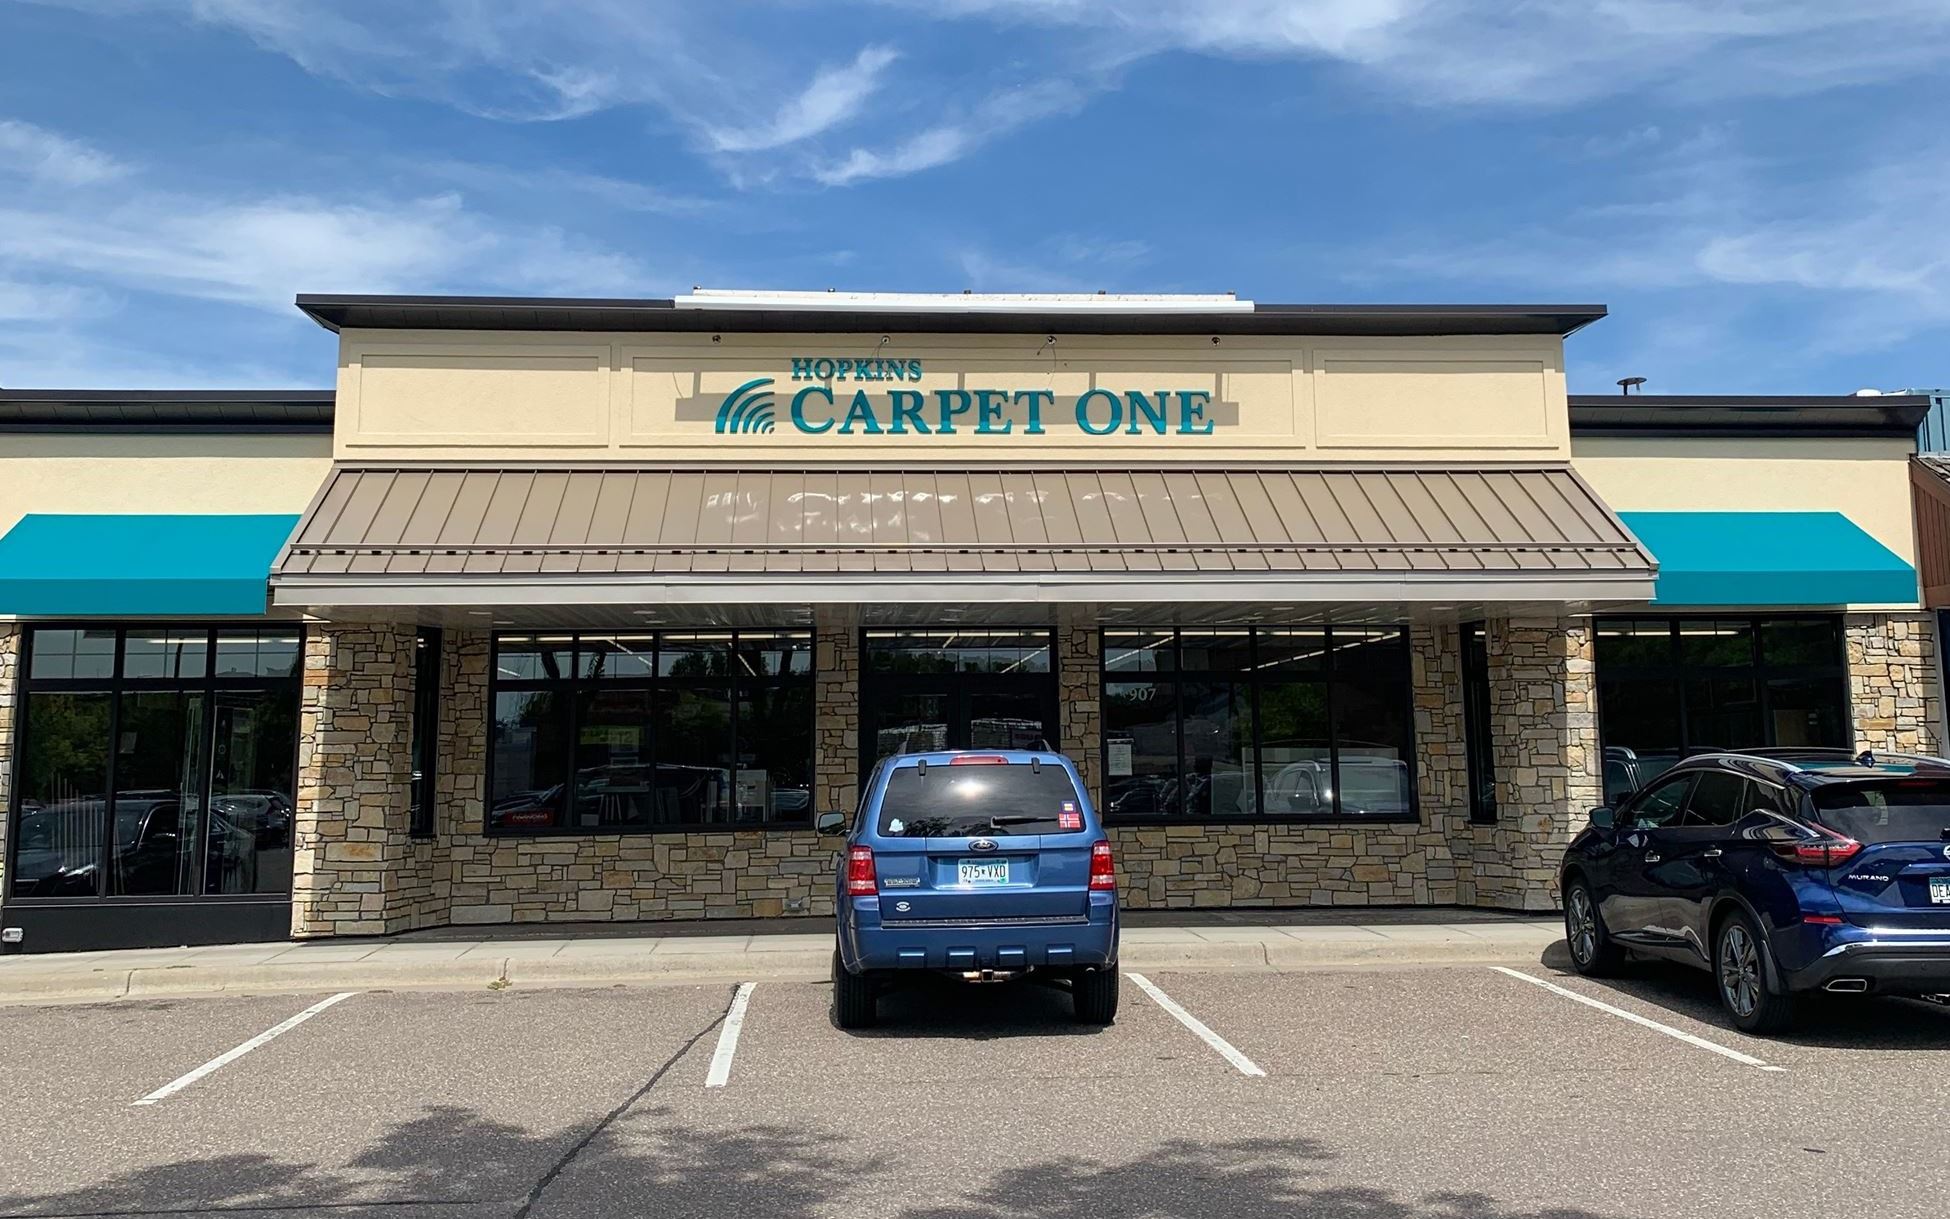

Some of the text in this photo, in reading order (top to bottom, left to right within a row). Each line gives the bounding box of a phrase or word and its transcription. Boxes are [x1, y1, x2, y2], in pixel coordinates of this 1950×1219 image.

[791, 357, 922, 382] HOPKINS
[791, 386, 1214, 436] CARPET ONE
